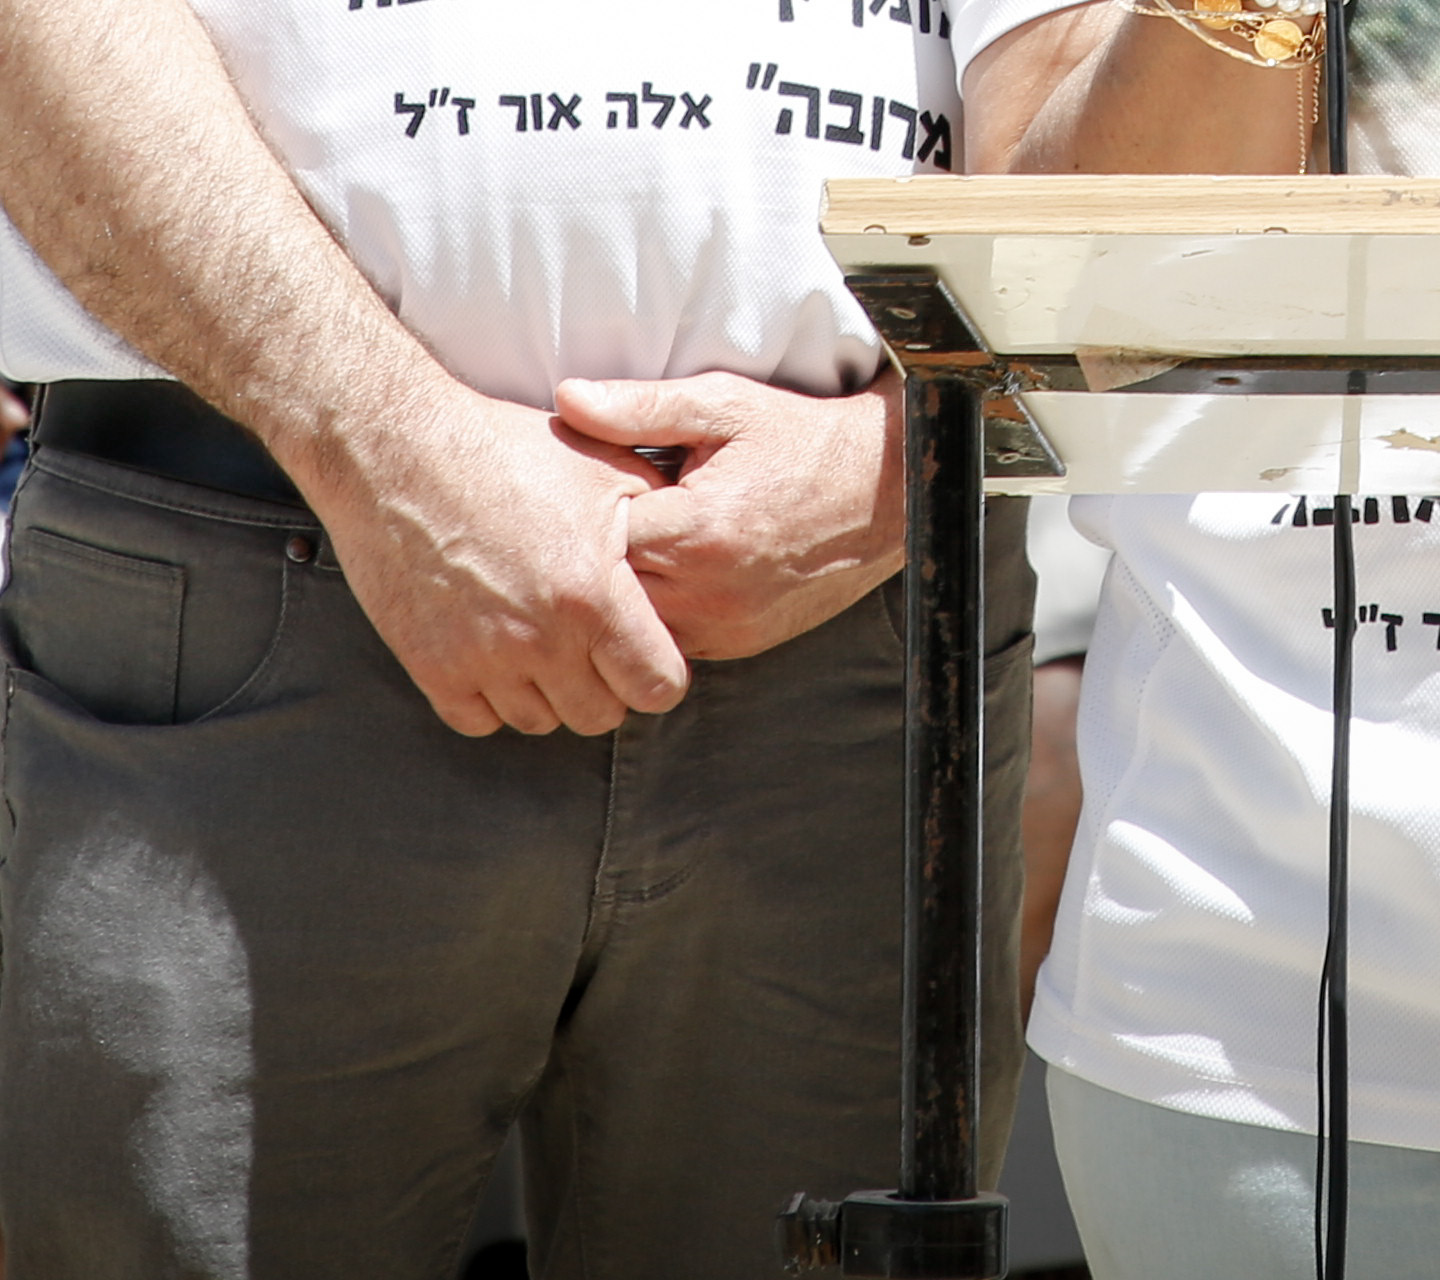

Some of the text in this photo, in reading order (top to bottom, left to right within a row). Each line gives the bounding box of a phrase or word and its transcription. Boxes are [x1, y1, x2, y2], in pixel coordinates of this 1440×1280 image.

[393, 62, 952, 172] מרובה" אלה אור ז"ל
